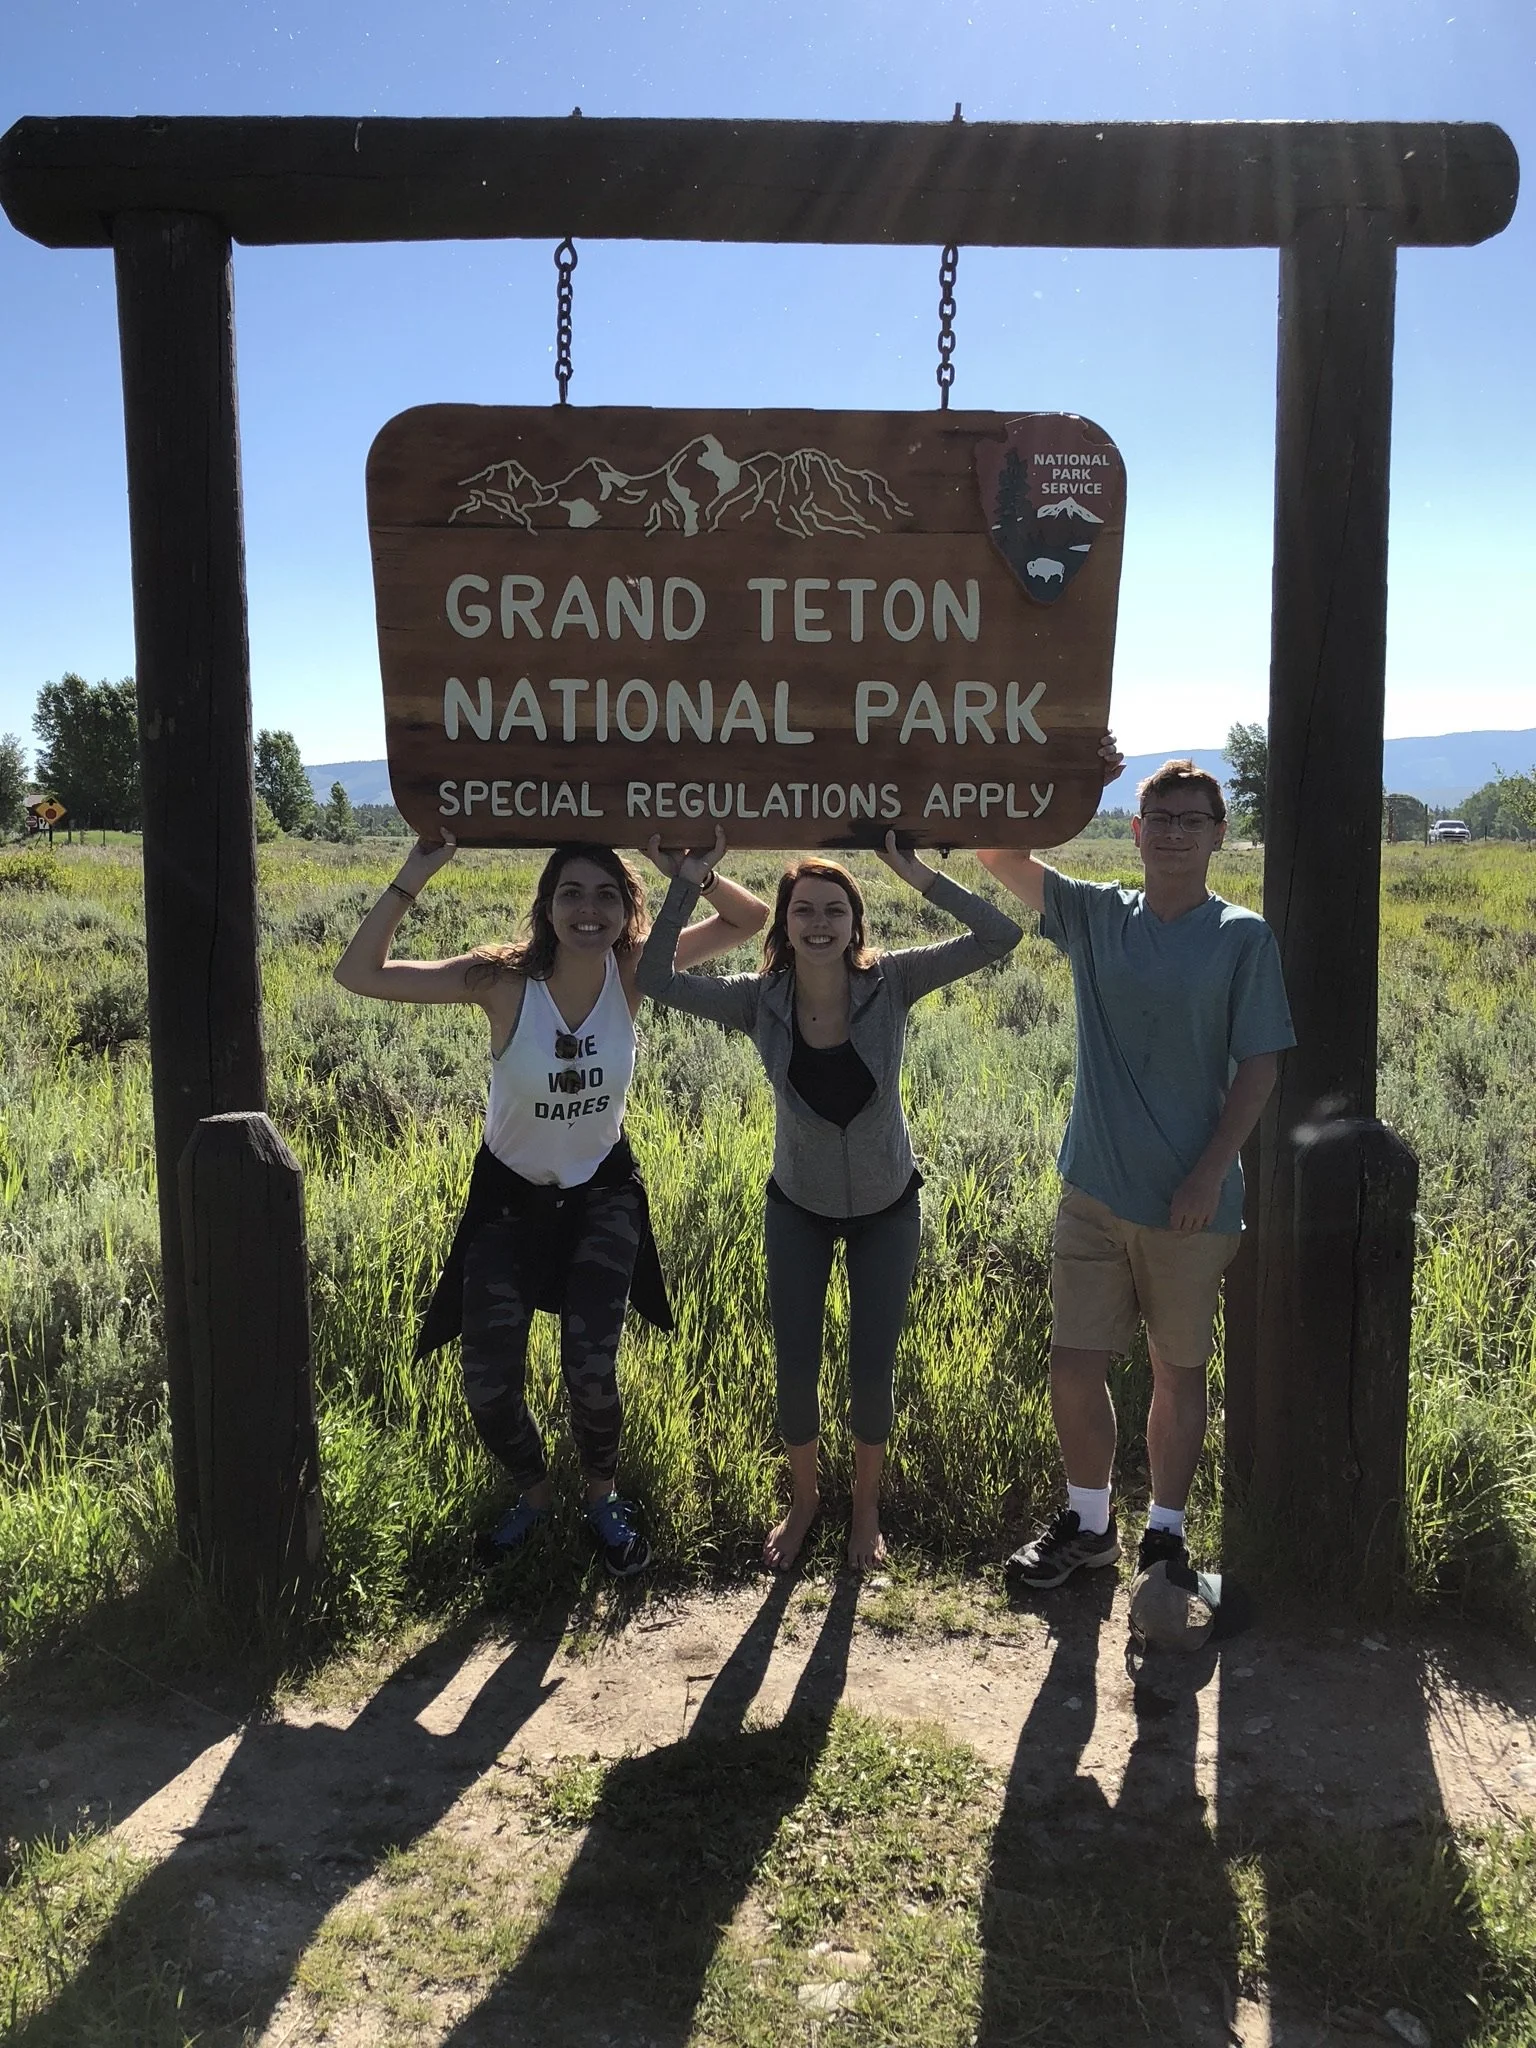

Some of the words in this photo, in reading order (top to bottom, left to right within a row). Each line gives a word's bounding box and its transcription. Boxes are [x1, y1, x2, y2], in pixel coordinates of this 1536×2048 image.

[1034, 453, 1110, 466] NATIONAL
[1052, 468, 1091, 480] PARK
[1041, 482, 1102, 495] SERVICE
[445, 573, 706, 641] GRAND
[747, 577, 980, 643] TETON
[444, 677, 814, 745] NATIONAL
[855, 680, 1048, 745] PARK
[438, 780, 604, 818] SPECIAL
[627, 781, 901, 819] REGULATIONS
[923, 782, 1055, 819] APPLY
[534, 1095, 610, 1121] DARES
